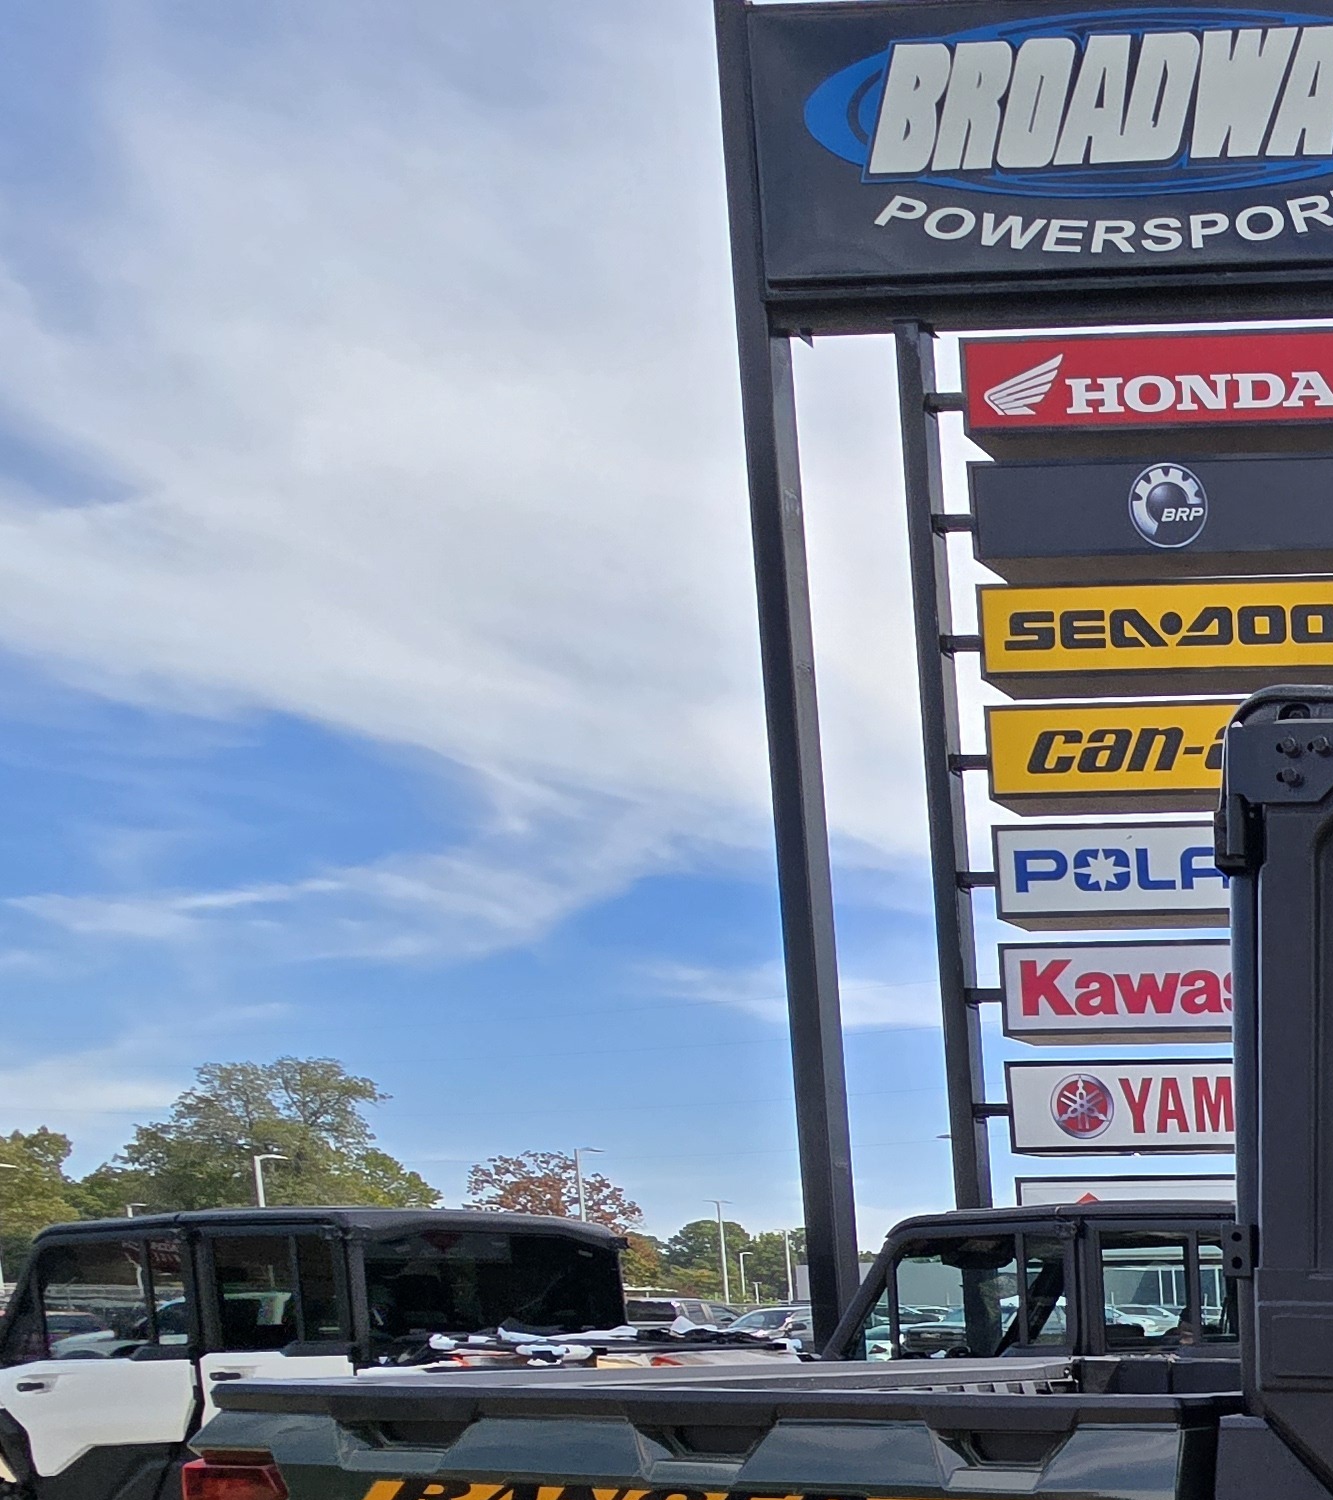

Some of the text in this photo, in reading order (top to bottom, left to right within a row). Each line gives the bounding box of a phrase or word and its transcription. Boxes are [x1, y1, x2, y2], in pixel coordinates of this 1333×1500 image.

[1160, 507, 1204, 522] BRP
[1020, 959, 1233, 1017] Kawa
[1118, 1075, 1235, 1134] YAM
